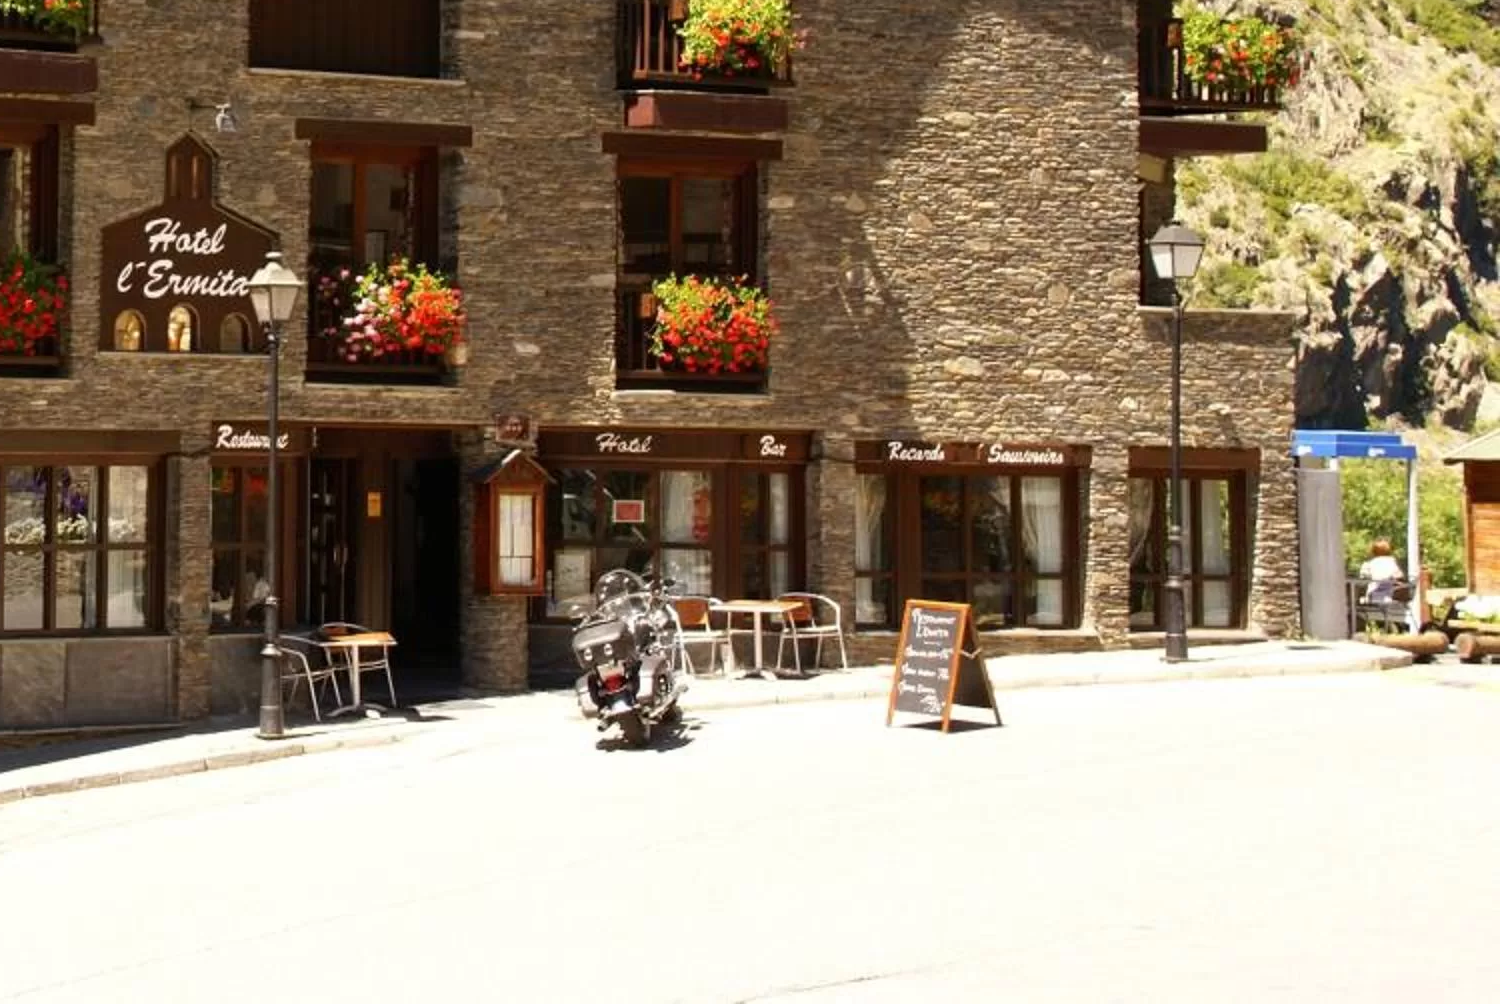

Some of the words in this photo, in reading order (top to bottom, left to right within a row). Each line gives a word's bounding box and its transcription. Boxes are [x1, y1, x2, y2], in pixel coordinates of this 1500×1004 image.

[144, 217, 227, 255] Hotel
[215, 423, 289, 449] Restaurt
[595, 432, 652, 453] Hotel
[759, 434, 787, 457] Bar
[887, 440, 946, 461] Records
